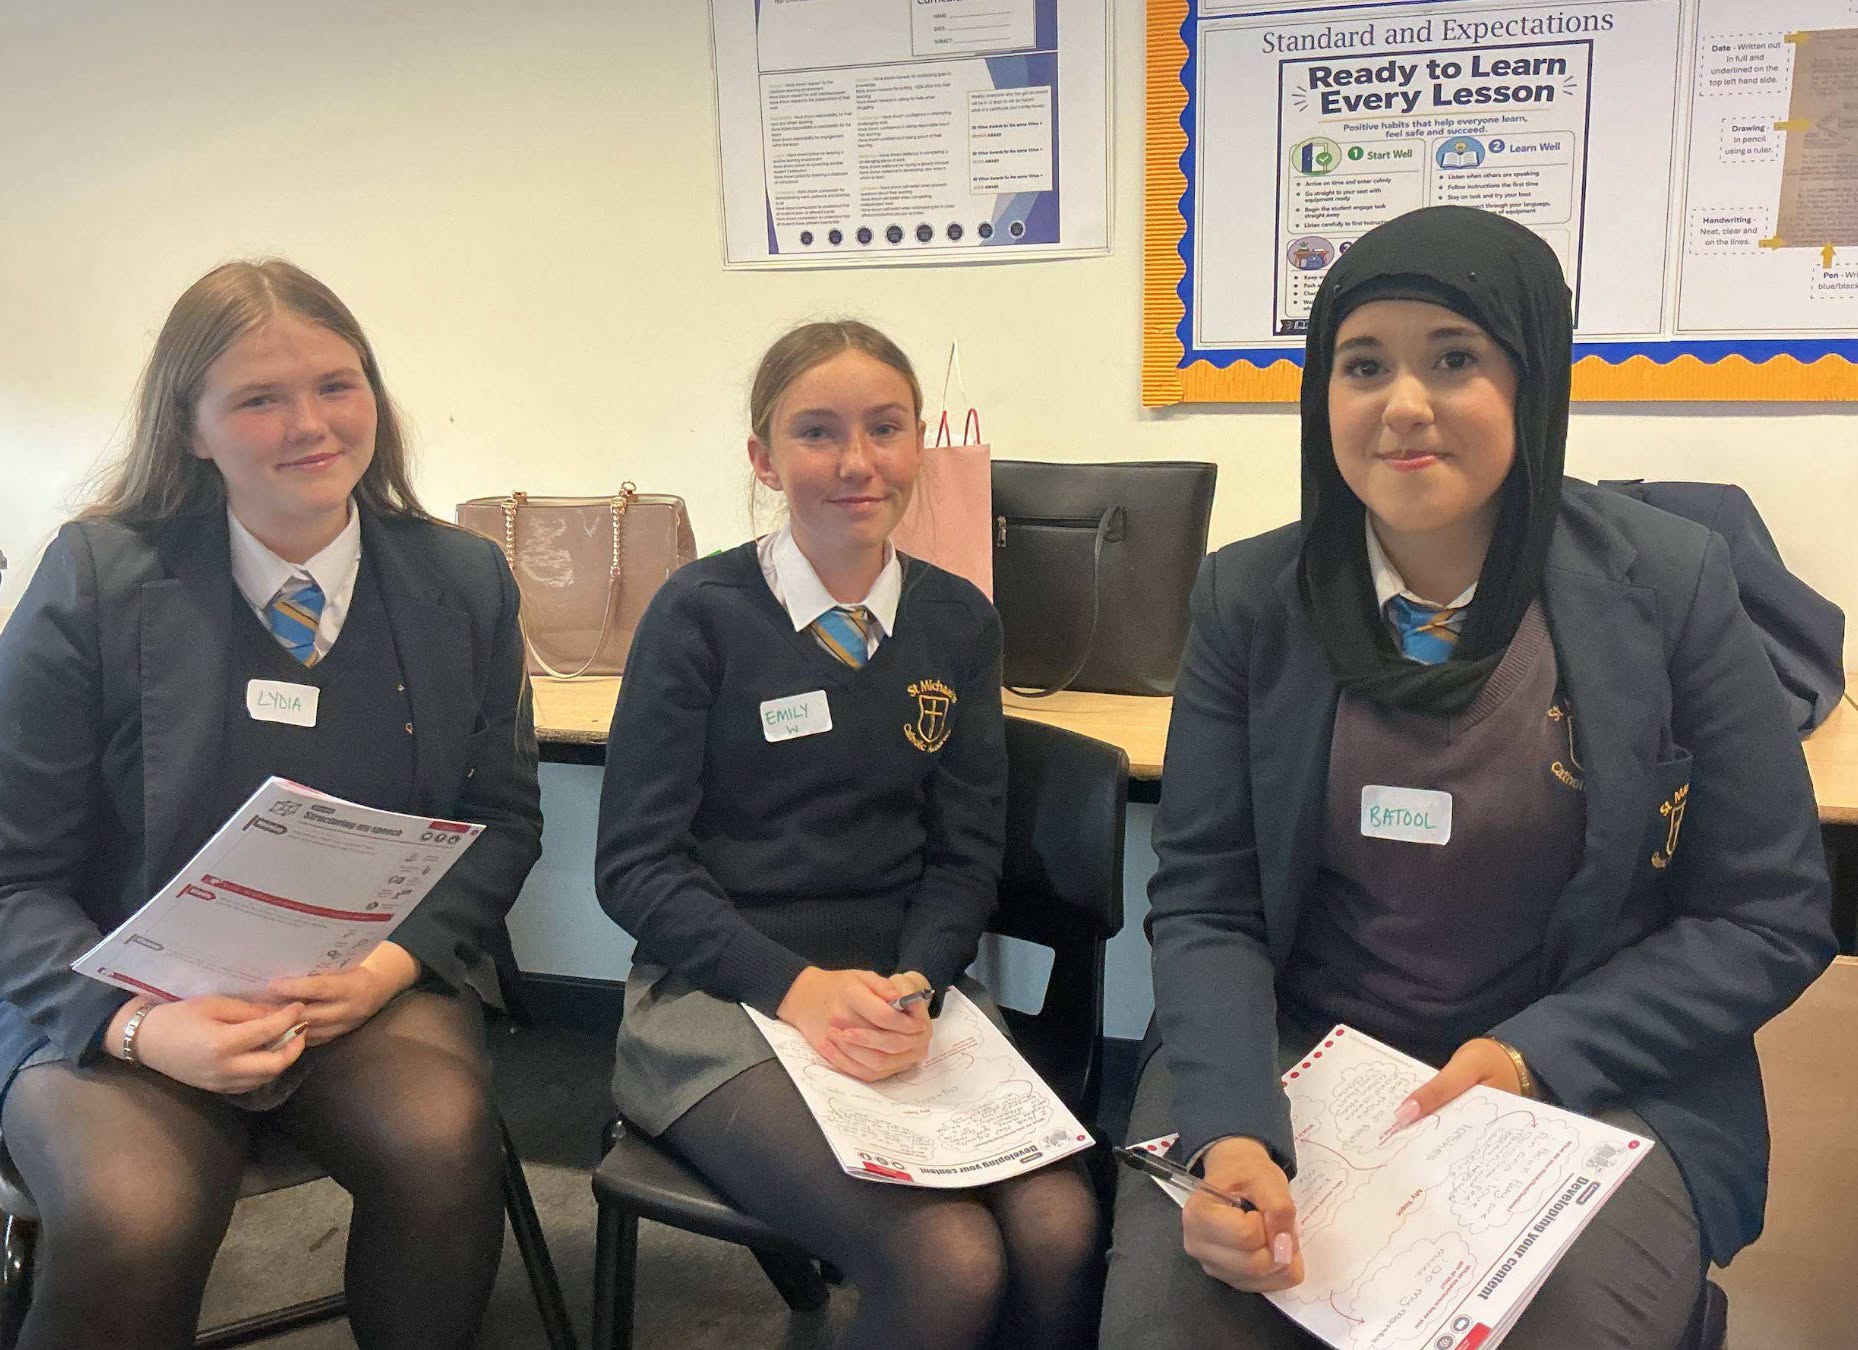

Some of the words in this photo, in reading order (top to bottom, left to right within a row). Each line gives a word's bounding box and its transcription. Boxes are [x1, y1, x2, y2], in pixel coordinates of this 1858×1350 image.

[1262, 25, 1374, 54] Standard
[1385, 21, 1432, 44] and
[1442, 12, 1614, 43] Expectations
[1308, 60, 1418, 89] Ready
[1426, 60, 1462, 80] to
[1471, 55, 1567, 78] Learn
[1711, 66, 1752, 75] underlined
[1709, 79, 1722, 87] top
[1724, 78, 1736, 86] left
[1759, 76, 1778, 84] side.
[1320, 89, 1421, 115] Every
[1432, 84, 1554, 106] Lesson
[1343, 123, 1378, 132] Positive
[1382, 121, 1409, 130] habits
[1412, 120, 1431, 128] that
[1435, 118, 1454, 128] help
[1457, 118, 1498, 127] everyone
[1502, 115, 1527, 124] learn,
[1731, 125, 1765, 133] Drawing
[1386, 130, 1402, 138] feel
[1405, 129, 1424, 137] safe
[1426, 128, 1444, 136] and
[1446, 126, 1488, 136] succeed.
[1742, 135, 1766, 144] pencil
[1510, 143, 1537, 153] Learn
[1540, 142, 1561, 151] Well
[1725, 147, 1746, 156] using
[1753, 146, 1774, 154] ruler.
[1367, 151, 1390, 160] Start
[1393, 149, 1413, 159] Well
[1513, 170, 1540, 178] speaking
[1372, 177, 1391, 185] calmly
[1702, 216, 1751, 225] Handwriting
[1700, 227, 1720, 236] Neat,
[1722, 227, 1741, 235] clear
[1742, 227, 1758, 235] and
[1716, 238, 1729, 246] the
[1730, 237, 1751, 246] lines.
[1823, 271, 1839, 279] Pen
[257, 690, 303, 711] LYDIA
[765, 704, 809, 725] EMILY
[786, 724, 799, 734] W
[1370, 805, 1437, 829] BATOOL
[982, 1144, 1038, 1169] Developing
[920, 1167, 958, 1175] content
[960, 1163, 982, 1173] your
[1410, 1187, 1423, 1201] My
[1394, 1197, 1413, 1218] Topic
[1531, 1174, 1588, 1236] Developing
[1512, 1229, 1538, 1258] your
[1476, 1256, 1518, 1302] content
